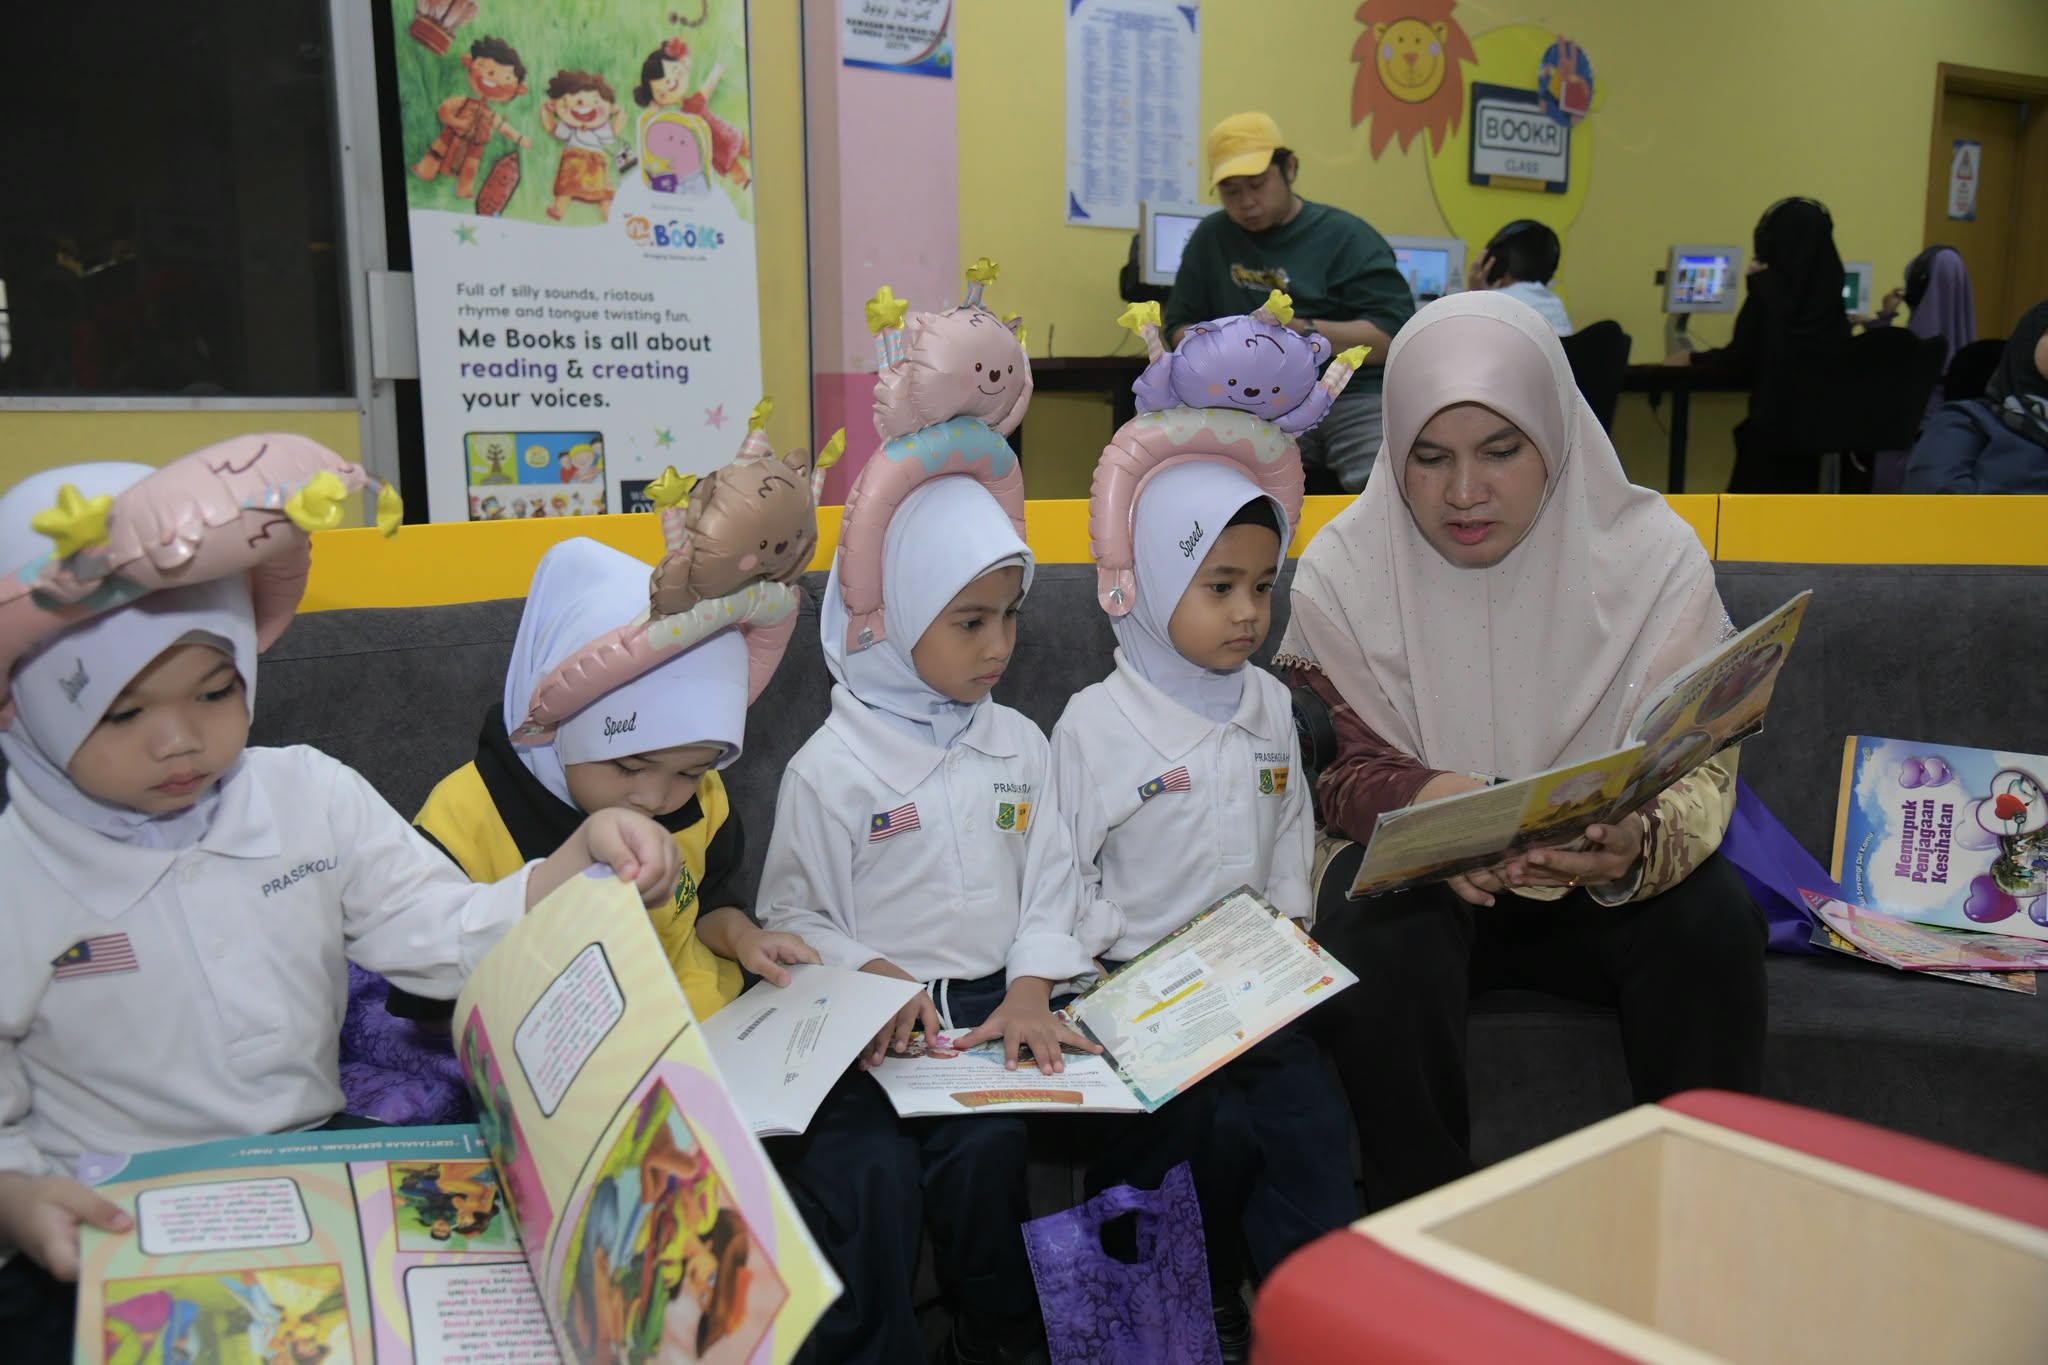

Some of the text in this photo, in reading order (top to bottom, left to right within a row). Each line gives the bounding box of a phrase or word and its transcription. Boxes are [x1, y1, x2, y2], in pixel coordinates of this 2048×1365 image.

[1486, 117, 1558, 146] BOOKR
[1505, 160, 1538, 173] CLASS
[457, 283, 655, 302] Full of silly sounds, riotous
[459, 304, 692, 324] rhyme and tongue twisting fun.
[459, 328, 712, 352] Me Books is all about
[461, 358, 689, 384] reading & creating
[462, 388, 611, 412] your voices.
[1179, 520, 1204, 560] Speed
[604, 711, 637, 744] Speed
[1895, 800, 1918, 878] Memupuk
[1911, 799, 1936, 883] Penjagaan
[1931, 803, 1954, 884] Kesihatan
